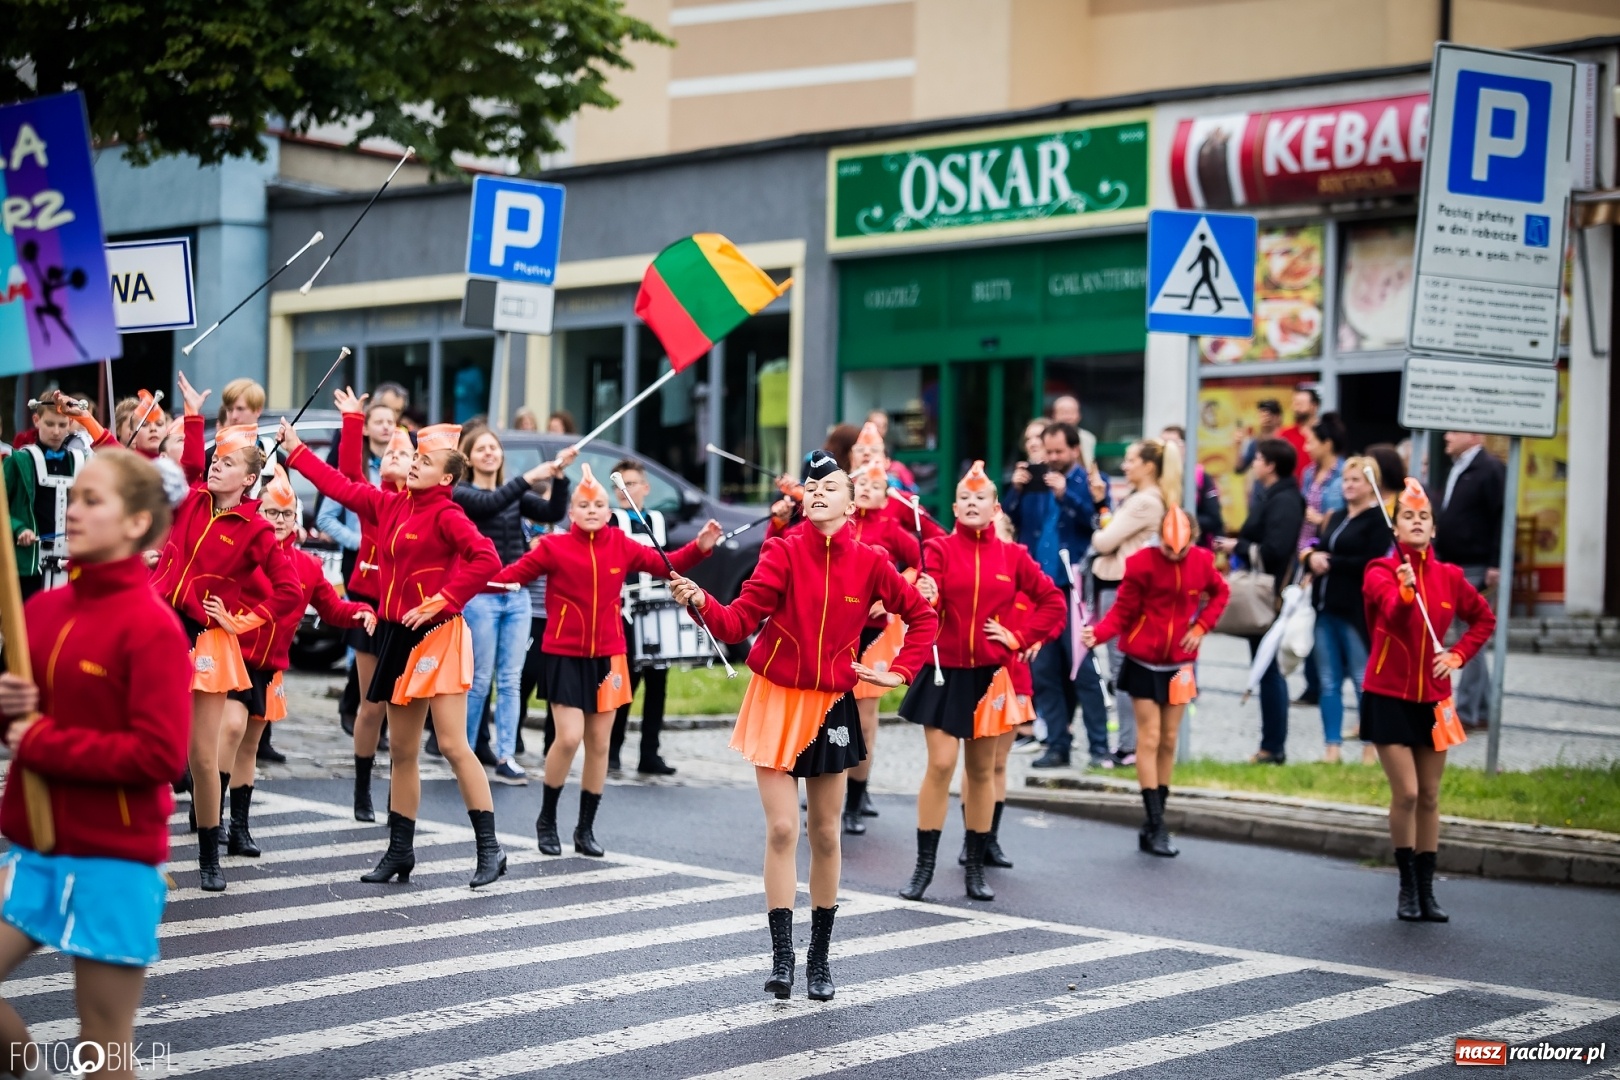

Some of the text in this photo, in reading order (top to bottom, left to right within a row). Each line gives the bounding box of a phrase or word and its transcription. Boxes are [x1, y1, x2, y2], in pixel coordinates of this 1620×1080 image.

[0, 122, 49, 171] A
[1471, 87, 1529, 181] P
[899, 141, 1073, 220] OSKAR
[489, 189, 545, 266] P
